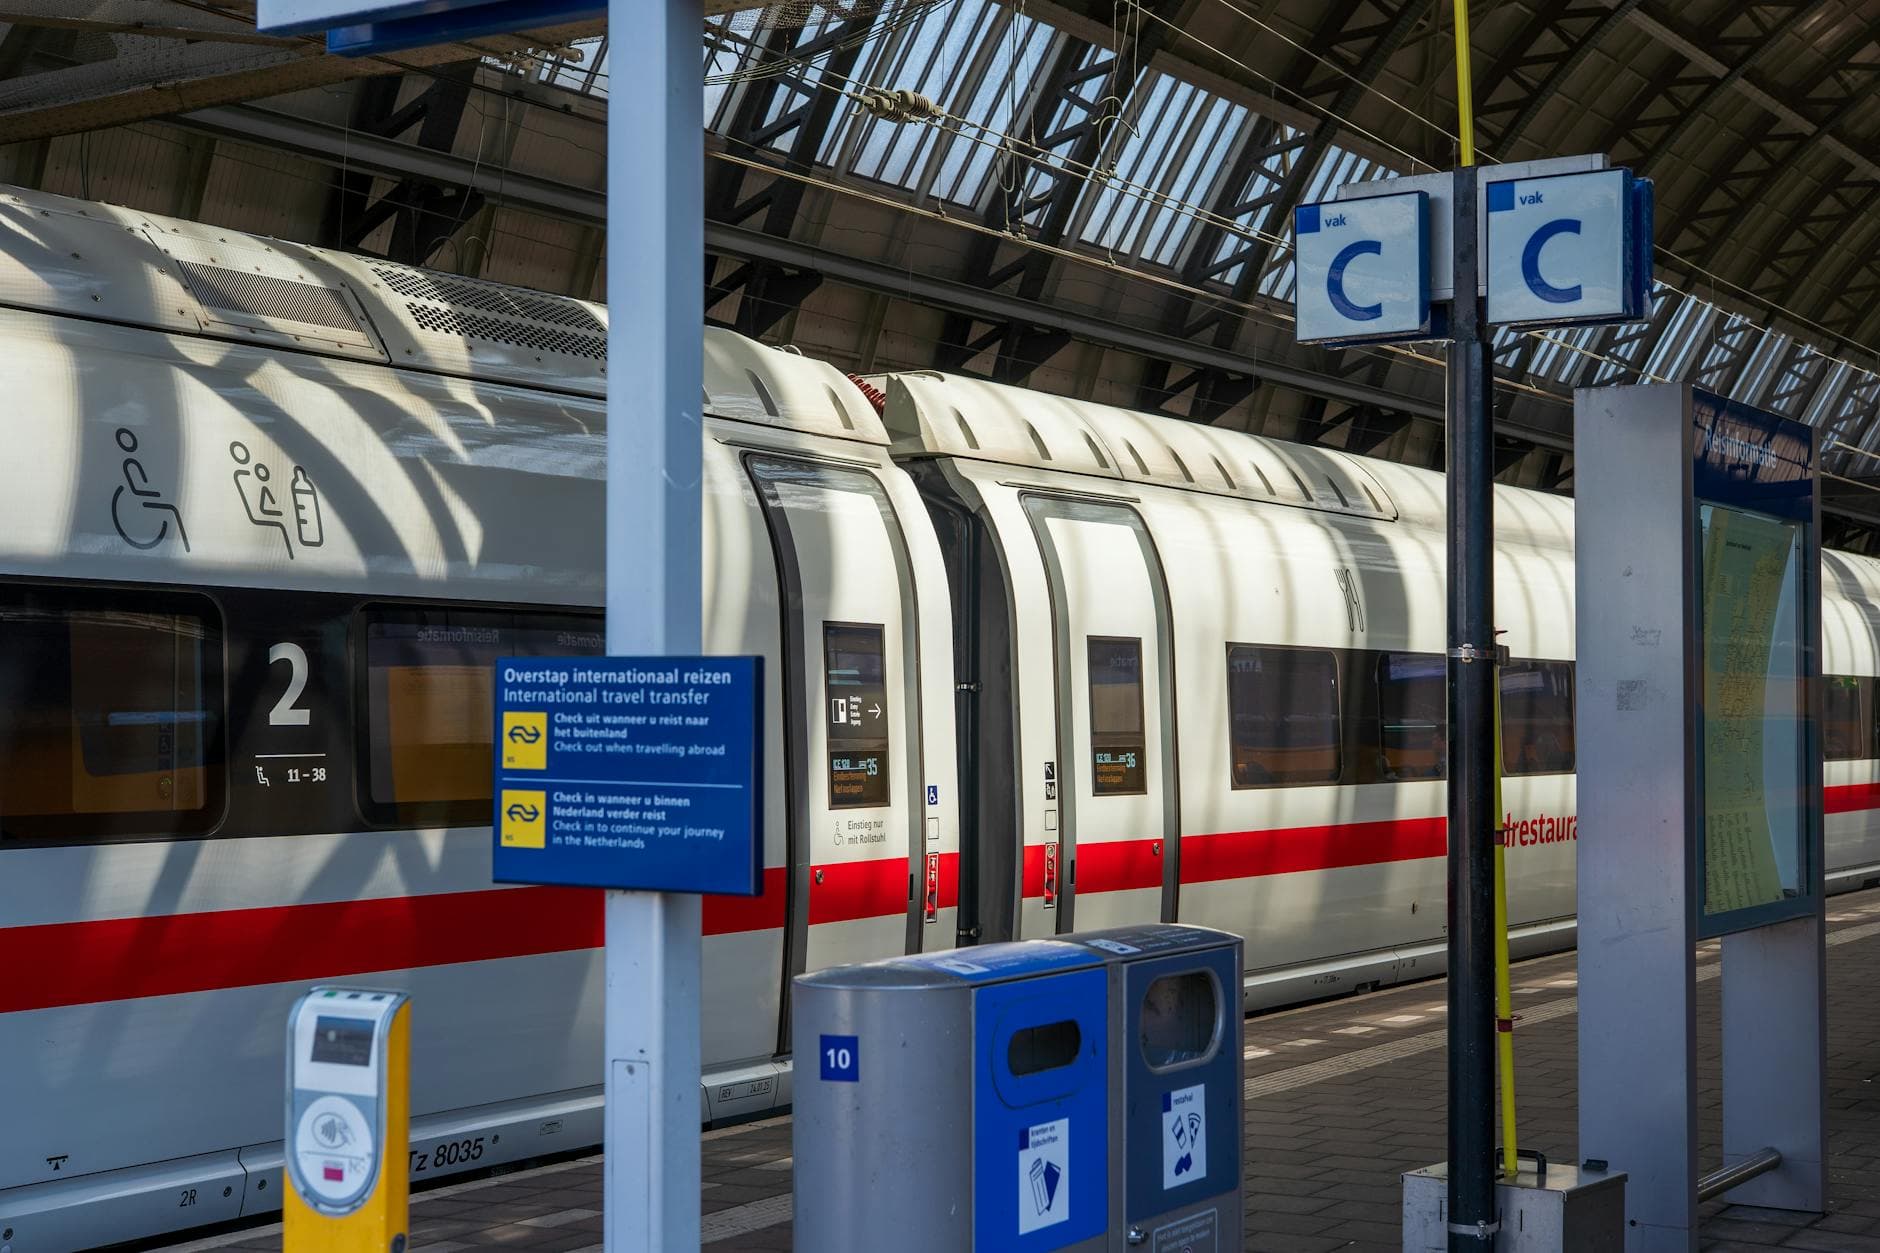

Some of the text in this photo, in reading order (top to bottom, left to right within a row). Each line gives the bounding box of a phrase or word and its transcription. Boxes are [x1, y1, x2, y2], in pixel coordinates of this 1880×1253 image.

[1518, 190, 1544, 205] vak
[1324, 213, 1347, 228] vak
[1521, 218, 1583, 304] C
[1326, 239, 1383, 322] C
[1704, 424, 1778, 470] Reisinformatie
[269, 642, 311, 726] 2
[504, 668, 732, 687] Overstap internationaal reizen
[504, 687, 710, 705] International travel transfer
[554, 712, 710, 726] Check uit wanneer u reist naar
[554, 726, 628, 739] het buitenland
[554, 740, 726, 757] Check out when travelling abroad
[866, 757, 878, 775] 35
[1126, 752, 1136, 768] 36
[288, 768, 300, 783] 11
[312, 767, 326, 783] 38
[553, 791, 690, 807] Check in wanneer u binnen
[553, 806, 666, 821] Nederland verder reist
[553, 820, 725, 841] Check in to continue your journey
[847, 820, 883, 831] Einstieg nur
[553, 835, 646, 849] in the Netherlands
[847, 832, 886, 845] mit Rollstuhl
[825, 1048, 851, 1070] 10
[433, 1138, 484, 1168] 8035
[180, 1189, 197, 1208] 2R
